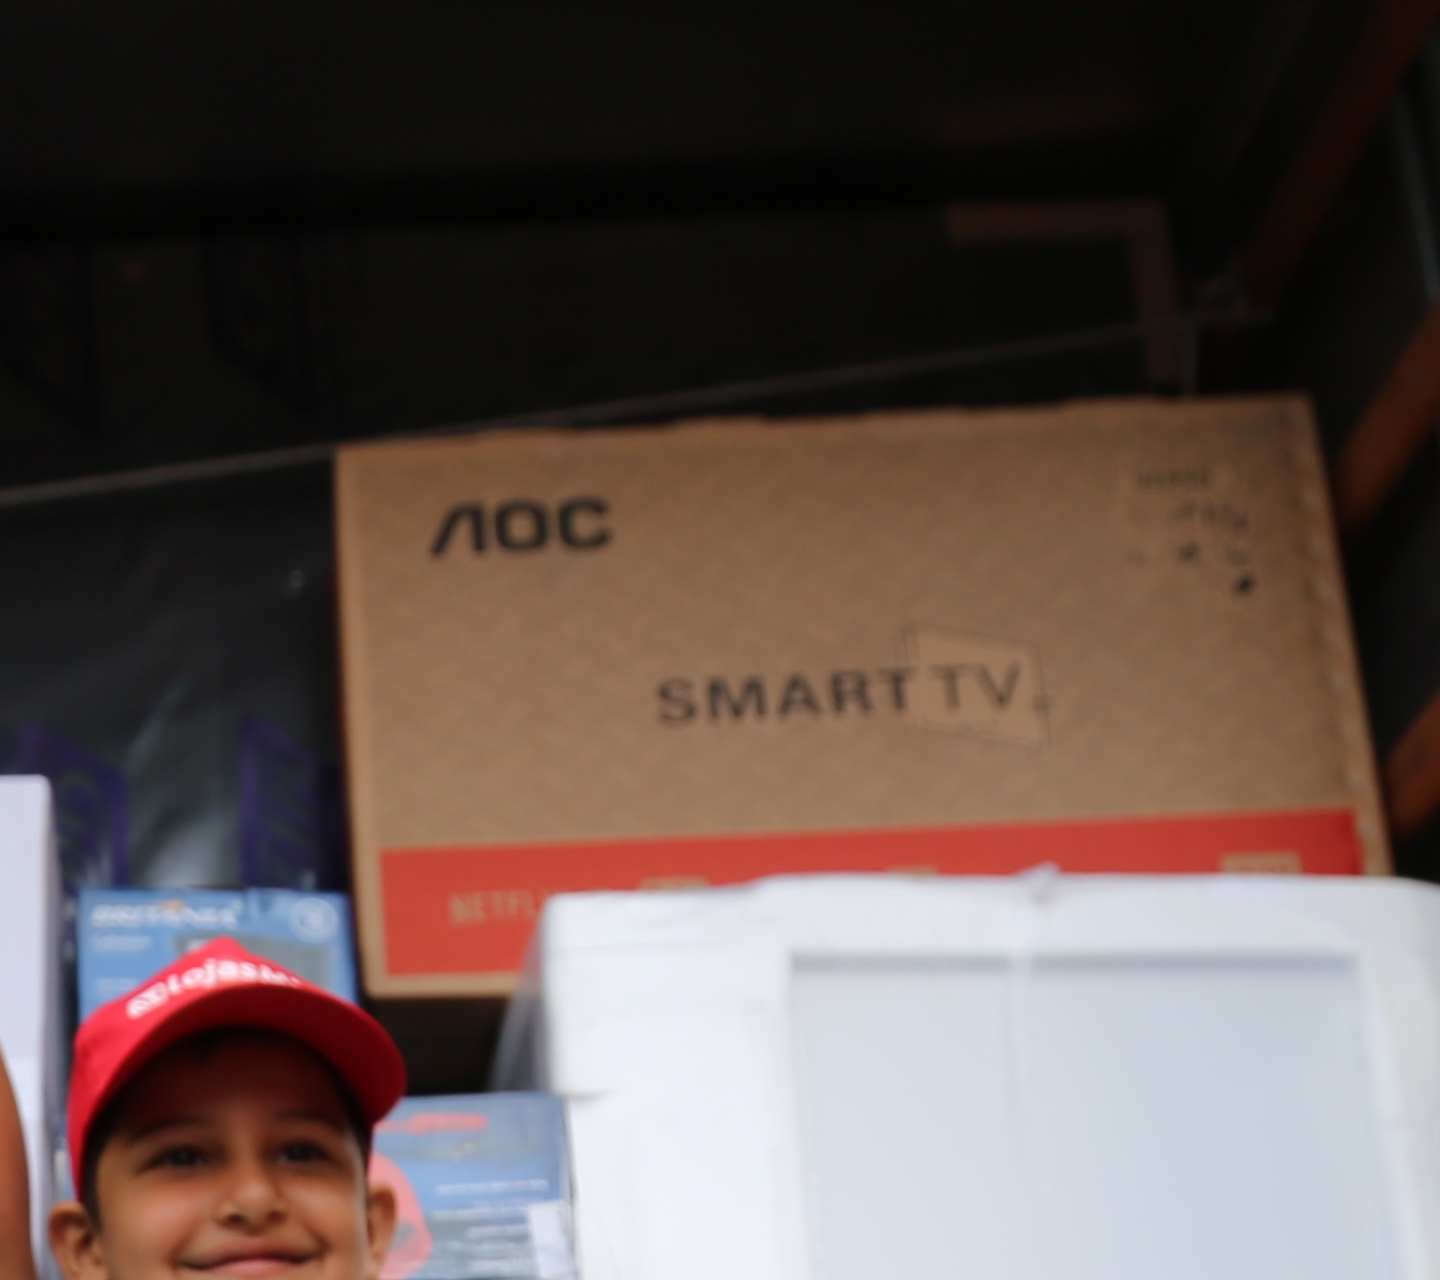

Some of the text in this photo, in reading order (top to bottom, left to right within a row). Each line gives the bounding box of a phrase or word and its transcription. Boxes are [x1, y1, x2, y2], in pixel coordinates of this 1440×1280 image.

[430, 496, 615, 560] AOC
[655, 660, 1024, 729] SMART TV
